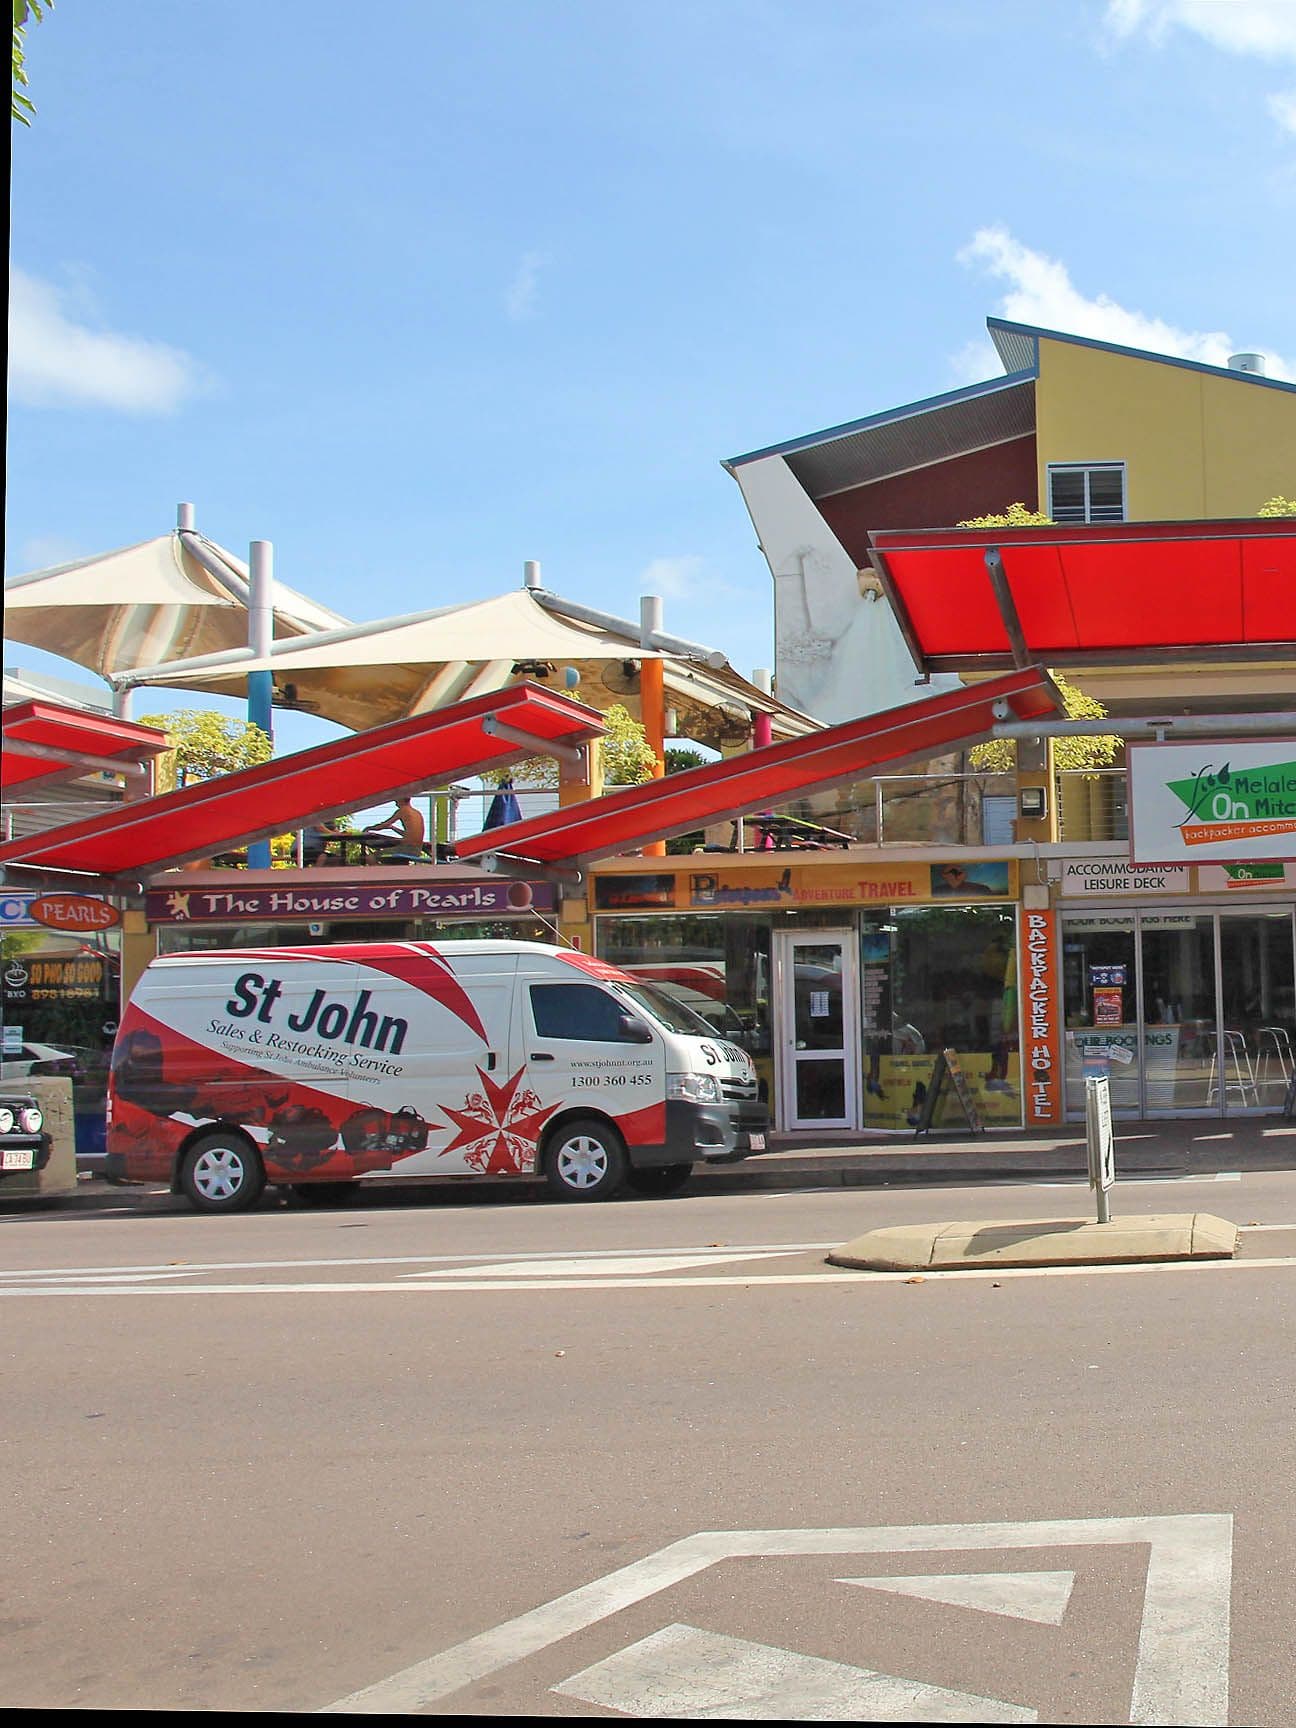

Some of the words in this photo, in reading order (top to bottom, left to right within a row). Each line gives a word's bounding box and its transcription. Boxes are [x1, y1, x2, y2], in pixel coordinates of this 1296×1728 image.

[1212, 792, 1249, 820] On
[1185, 826, 1246, 840] backpacker
[858, 881, 917, 899] TRAVEL
[1084, 878, 1130, 890] LEISURE
[1134, 877, 1166, 889] DECK
[202, 894, 259, 912] The
[270, 892, 358, 912] House
[369, 890, 403, 909] of
[410, 888, 496, 908] Pearls
[41, 902, 110, 923] PEARLS
[1028, 914, 1049, 1038] BACKPACKER
[226, 972, 282, 1023] St
[287, 988, 409, 1055] John
[206, 1019, 245, 1041] Sales
[248, 1029, 263, 1044] &
[266, 1033, 348, 1066] Restocking
[349, 1053, 403, 1077] Service
[700, 1044, 721, 1066] St
[718, 1041, 746, 1064] John
[220, 1040, 263, 1061] Supporting
[264, 1051, 274, 1061] St
[274, 1052, 293, 1064] John
[295, 1059, 338, 1075] Ambulance
[339, 1067, 381, 1085] Volunteers
[570, 1058, 653, 1069] www.stjohnnt.org.au
[571, 1076, 600, 1088] 1300
[603, 1075, 626, 1087] 360
[630, 1074, 652, 1086] 455
